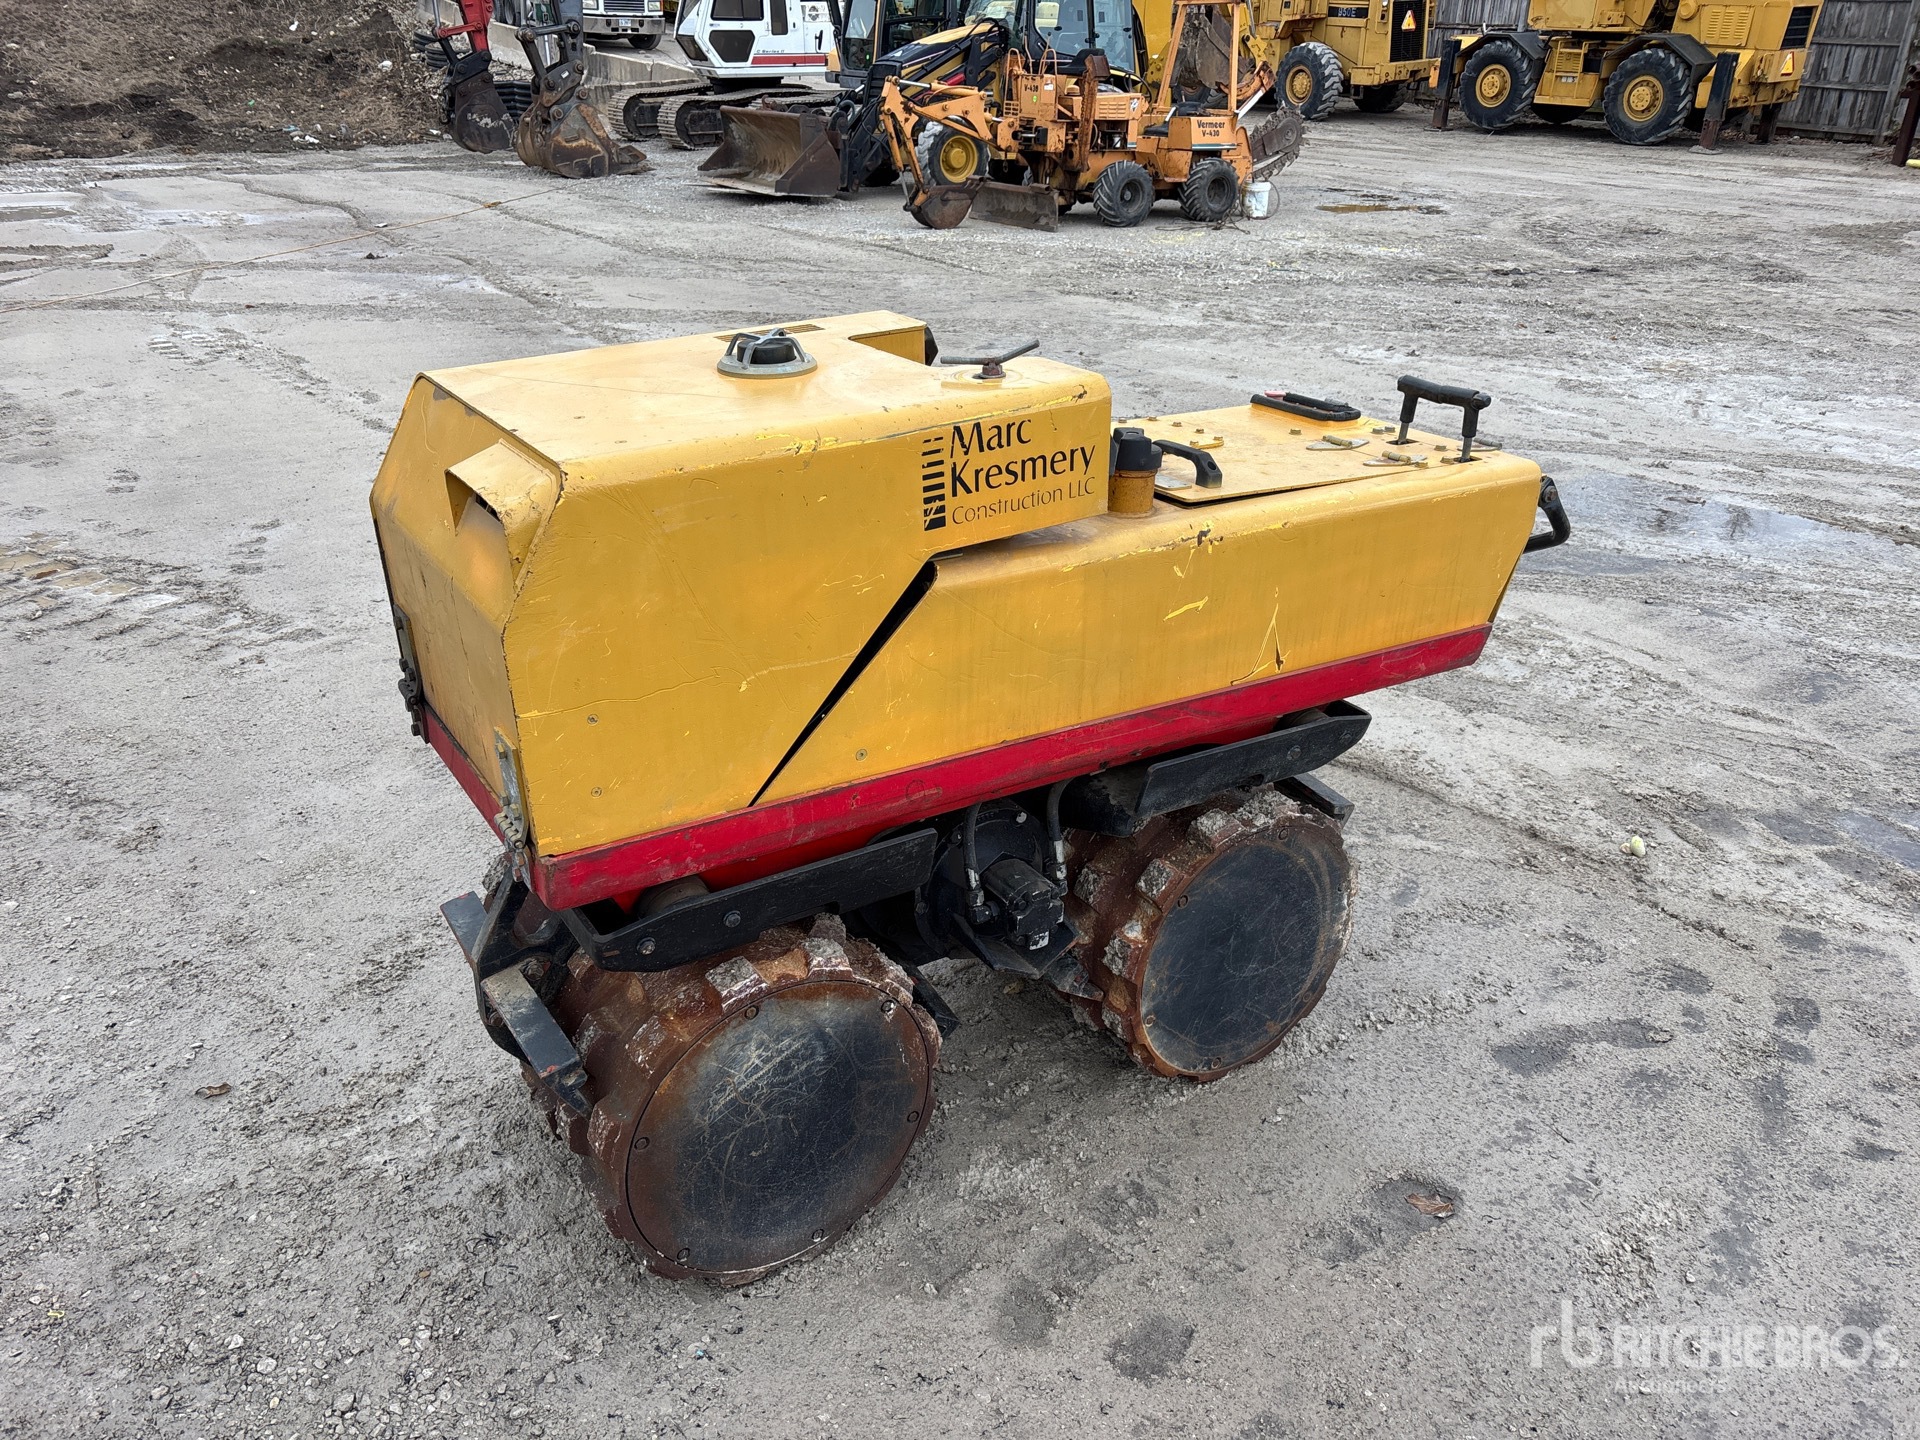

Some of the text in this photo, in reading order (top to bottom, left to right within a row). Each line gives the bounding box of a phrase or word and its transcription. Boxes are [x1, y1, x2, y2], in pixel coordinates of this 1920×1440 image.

[1197, 120, 1225, 128] Vermeer
[1201, 129, 1220, 137] V-430
[950, 419, 1032, 459] Marc
[951, 445, 1096, 498] Kresmery
[952, 476, 1095, 524] Construction LLC
